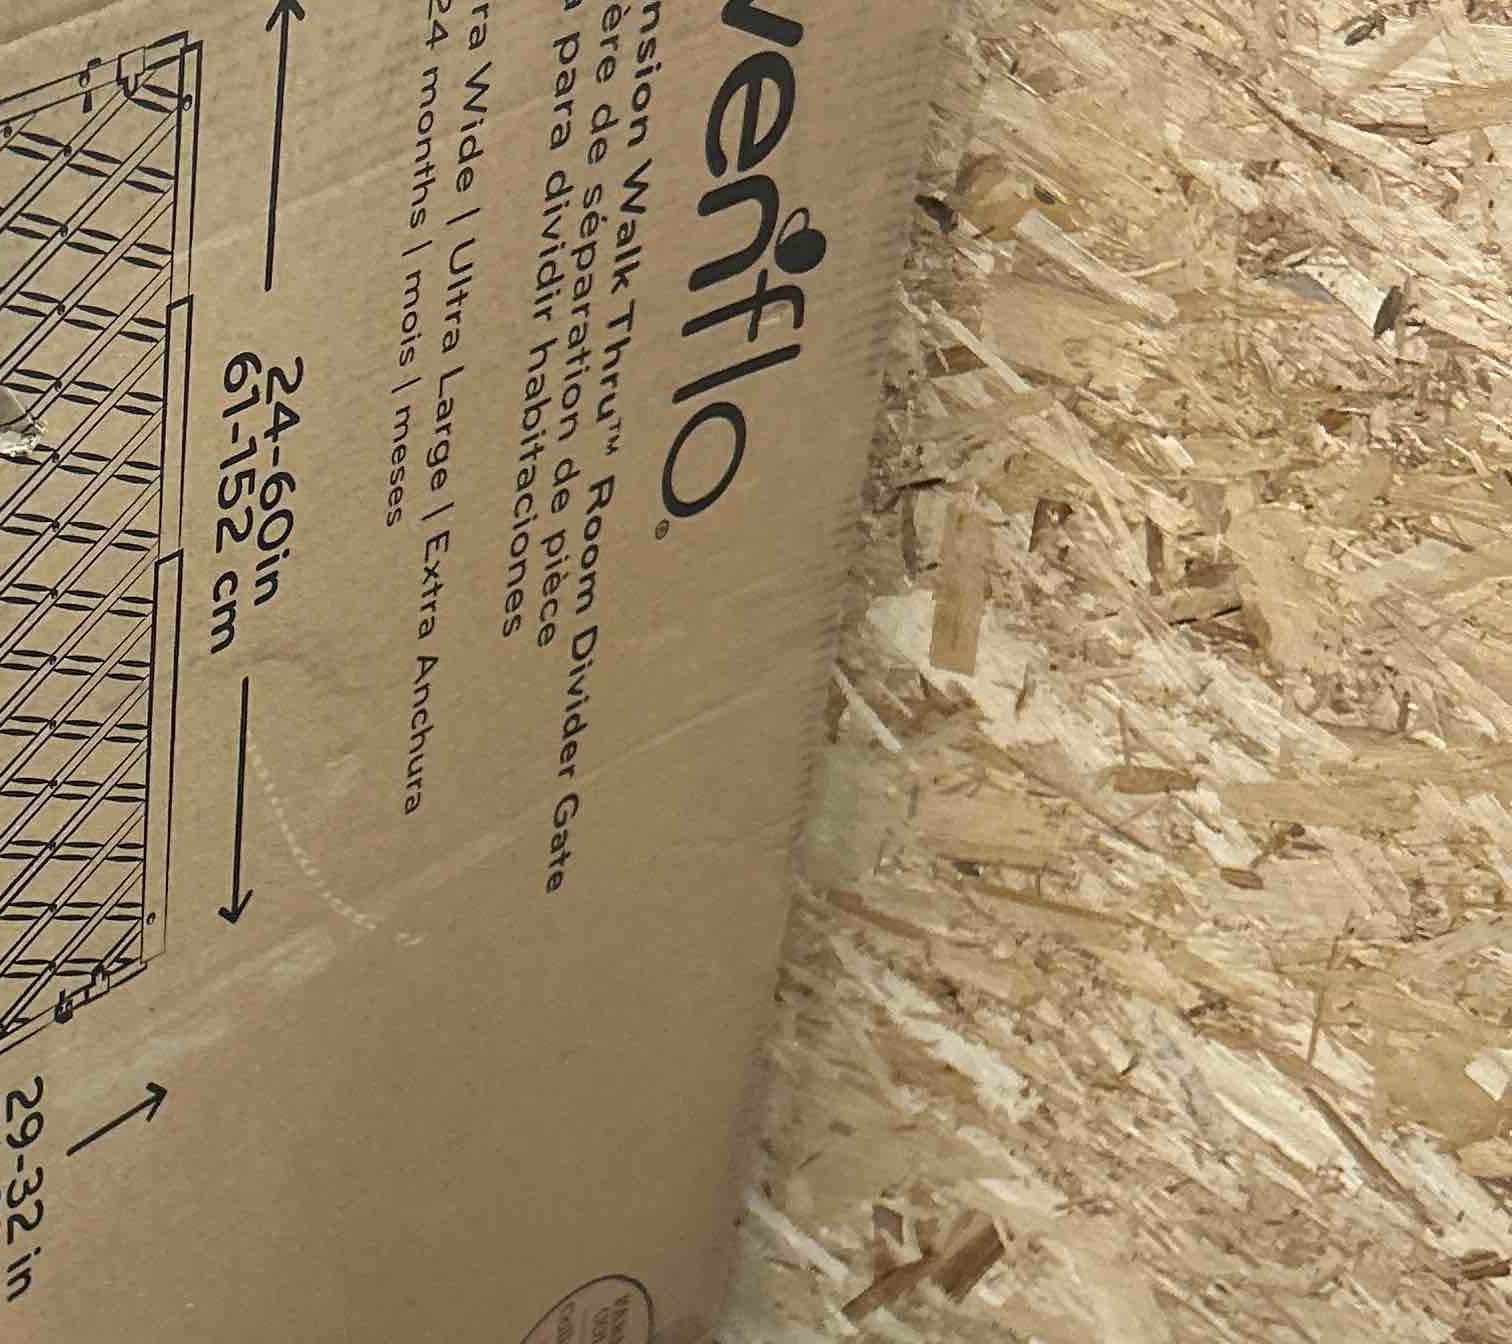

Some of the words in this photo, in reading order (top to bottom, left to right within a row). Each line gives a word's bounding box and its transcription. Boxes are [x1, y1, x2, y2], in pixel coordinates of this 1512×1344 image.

[409, 65, 440, 230] months
[456, 60, 493, 193] Wide
[550, 31, 581, 151] para
[588, 103, 620, 165] de
[533, 169, 574, 321] dividir
[611, 158, 653, 295] Walk
[399, 268, 423, 368] mois
[441, 237, 476, 354] Ultra
[558, 183, 608, 442] séparation
[215, 351, 263, 555] 61-152
[385, 404, 412, 528] meses
[426, 364, 466, 492] Large
[502, 337, 559, 639] habitaciones
[550, 457, 581, 515] de
[417, 529, 451, 640] Extra
[537, 529, 570, 649] pièce
[575, 474, 616, 615] Room
[210, 569, 239, 656] cm
[404, 656, 439, 816] Anchura
[557, 625, 598, 779] Divider
[546, 792, 580, 894] Gate
[5, 1075, 45, 1245] 29-32
[6, 1246, 42, 1303] in
